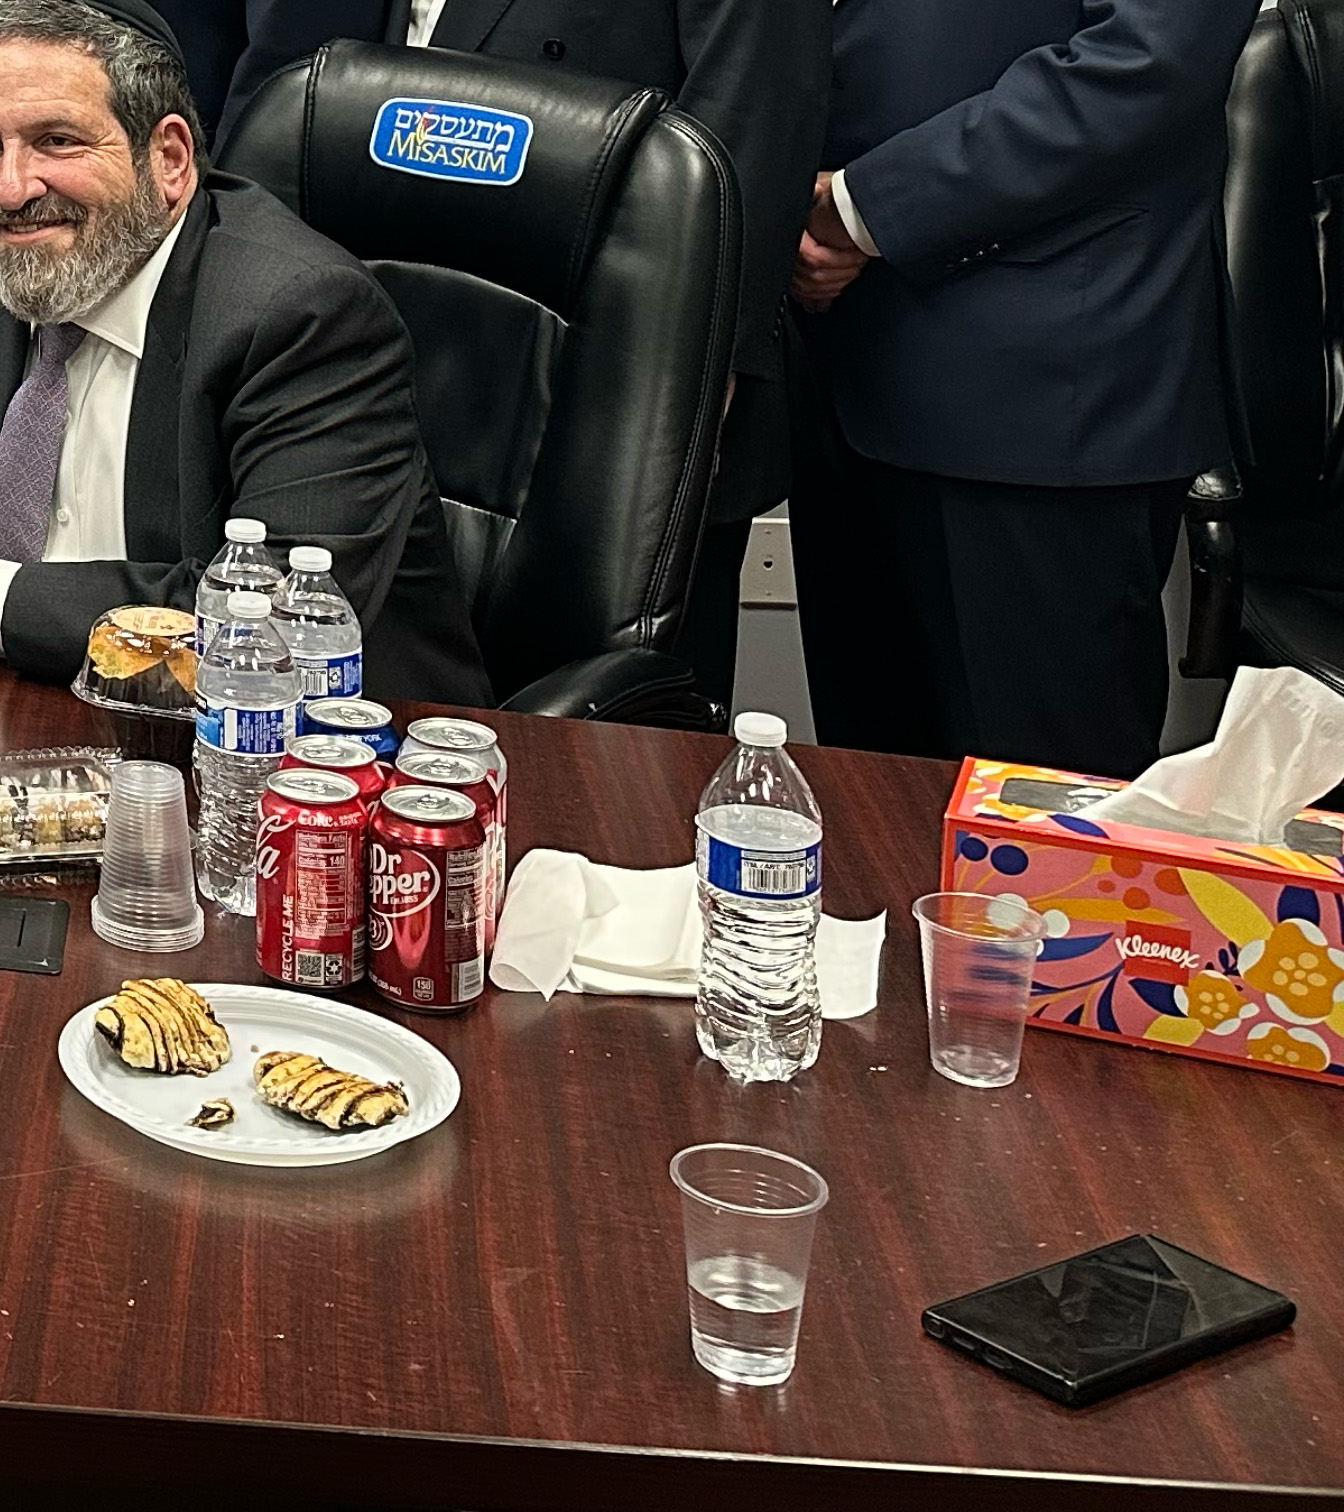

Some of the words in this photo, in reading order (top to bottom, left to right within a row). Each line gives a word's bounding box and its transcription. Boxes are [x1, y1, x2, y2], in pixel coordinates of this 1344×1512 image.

[372, 843, 402, 875] Dr
[370, 870, 431, 905] pper
[282, 894, 294, 918] ME
[281, 919, 294, 982] RECYCLE
[1115, 934, 1201, 968] Kleenex
